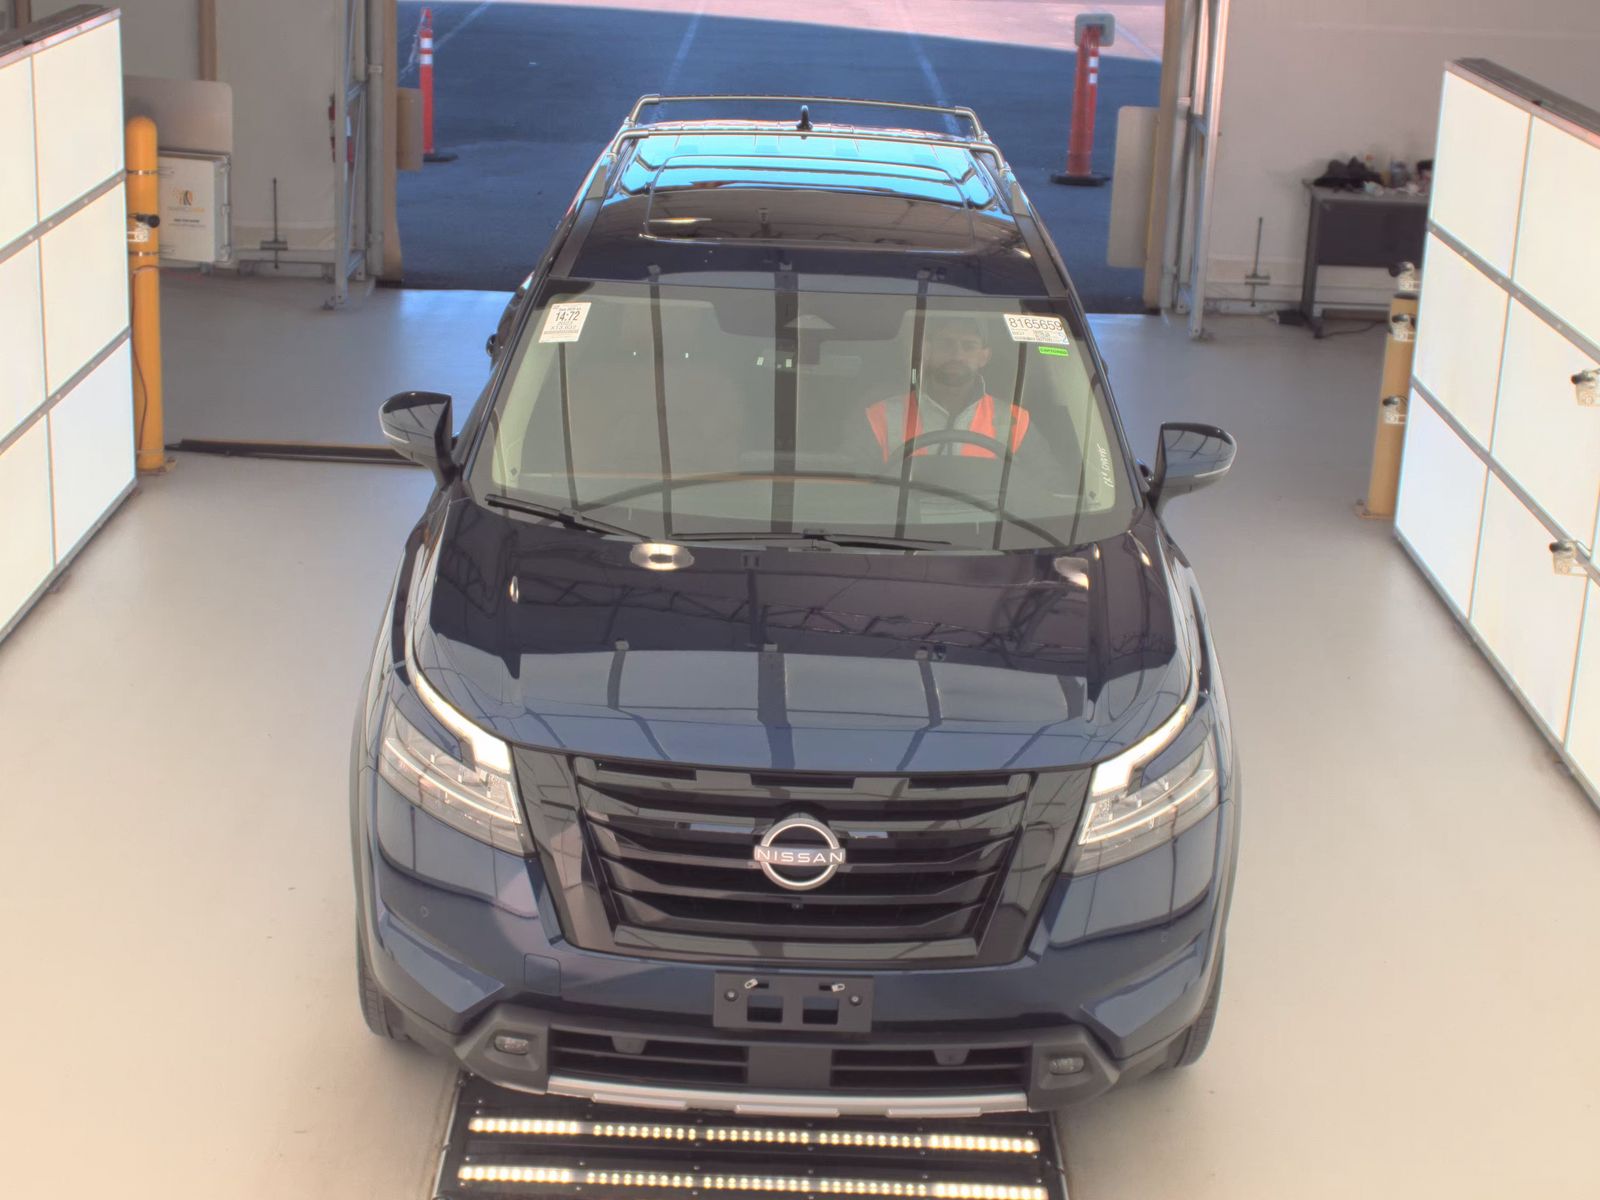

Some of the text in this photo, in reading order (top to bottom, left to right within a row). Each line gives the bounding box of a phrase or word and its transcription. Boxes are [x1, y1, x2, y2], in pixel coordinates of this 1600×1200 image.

[555, 310, 581, 322] 14:72
[1008, 317, 1063, 331] 8165659
[757, 848, 843, 863] NISSAN
